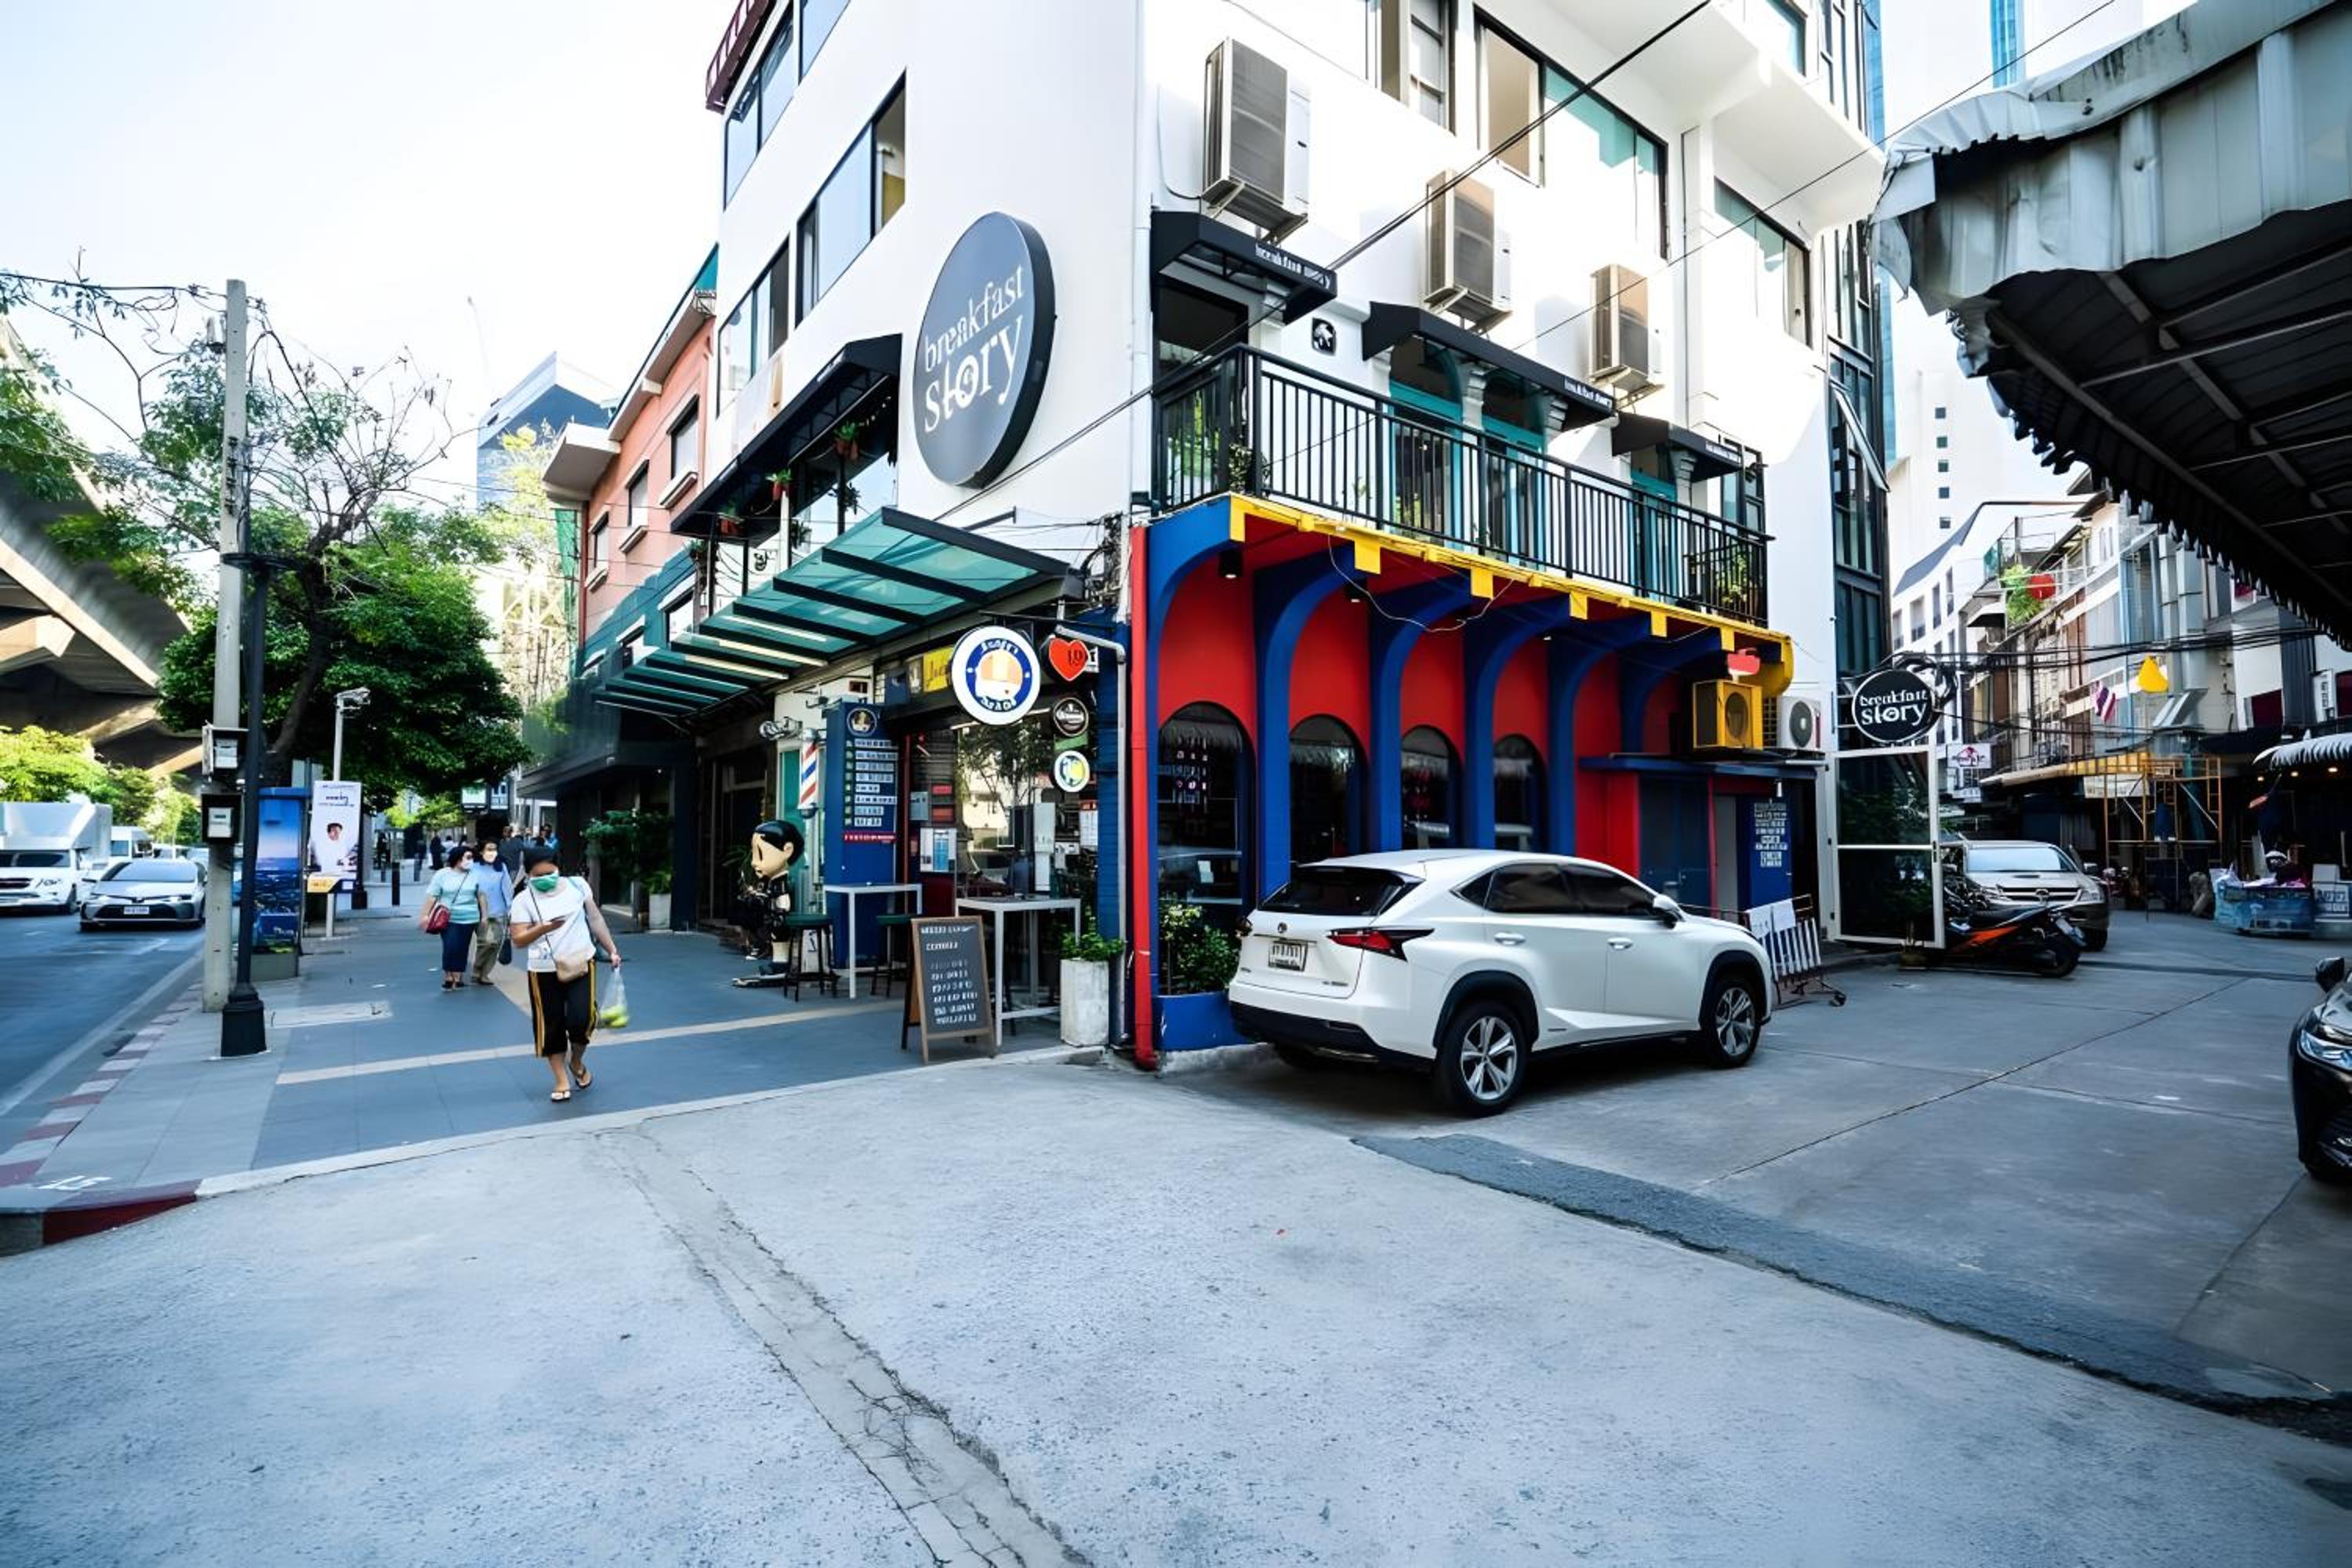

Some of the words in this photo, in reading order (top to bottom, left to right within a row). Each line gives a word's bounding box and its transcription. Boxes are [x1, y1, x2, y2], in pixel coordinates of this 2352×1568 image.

[924, 263, 1023, 373] breakfast
[924, 314, 1023, 433] story
[1860, 702, 1926, 726] story
